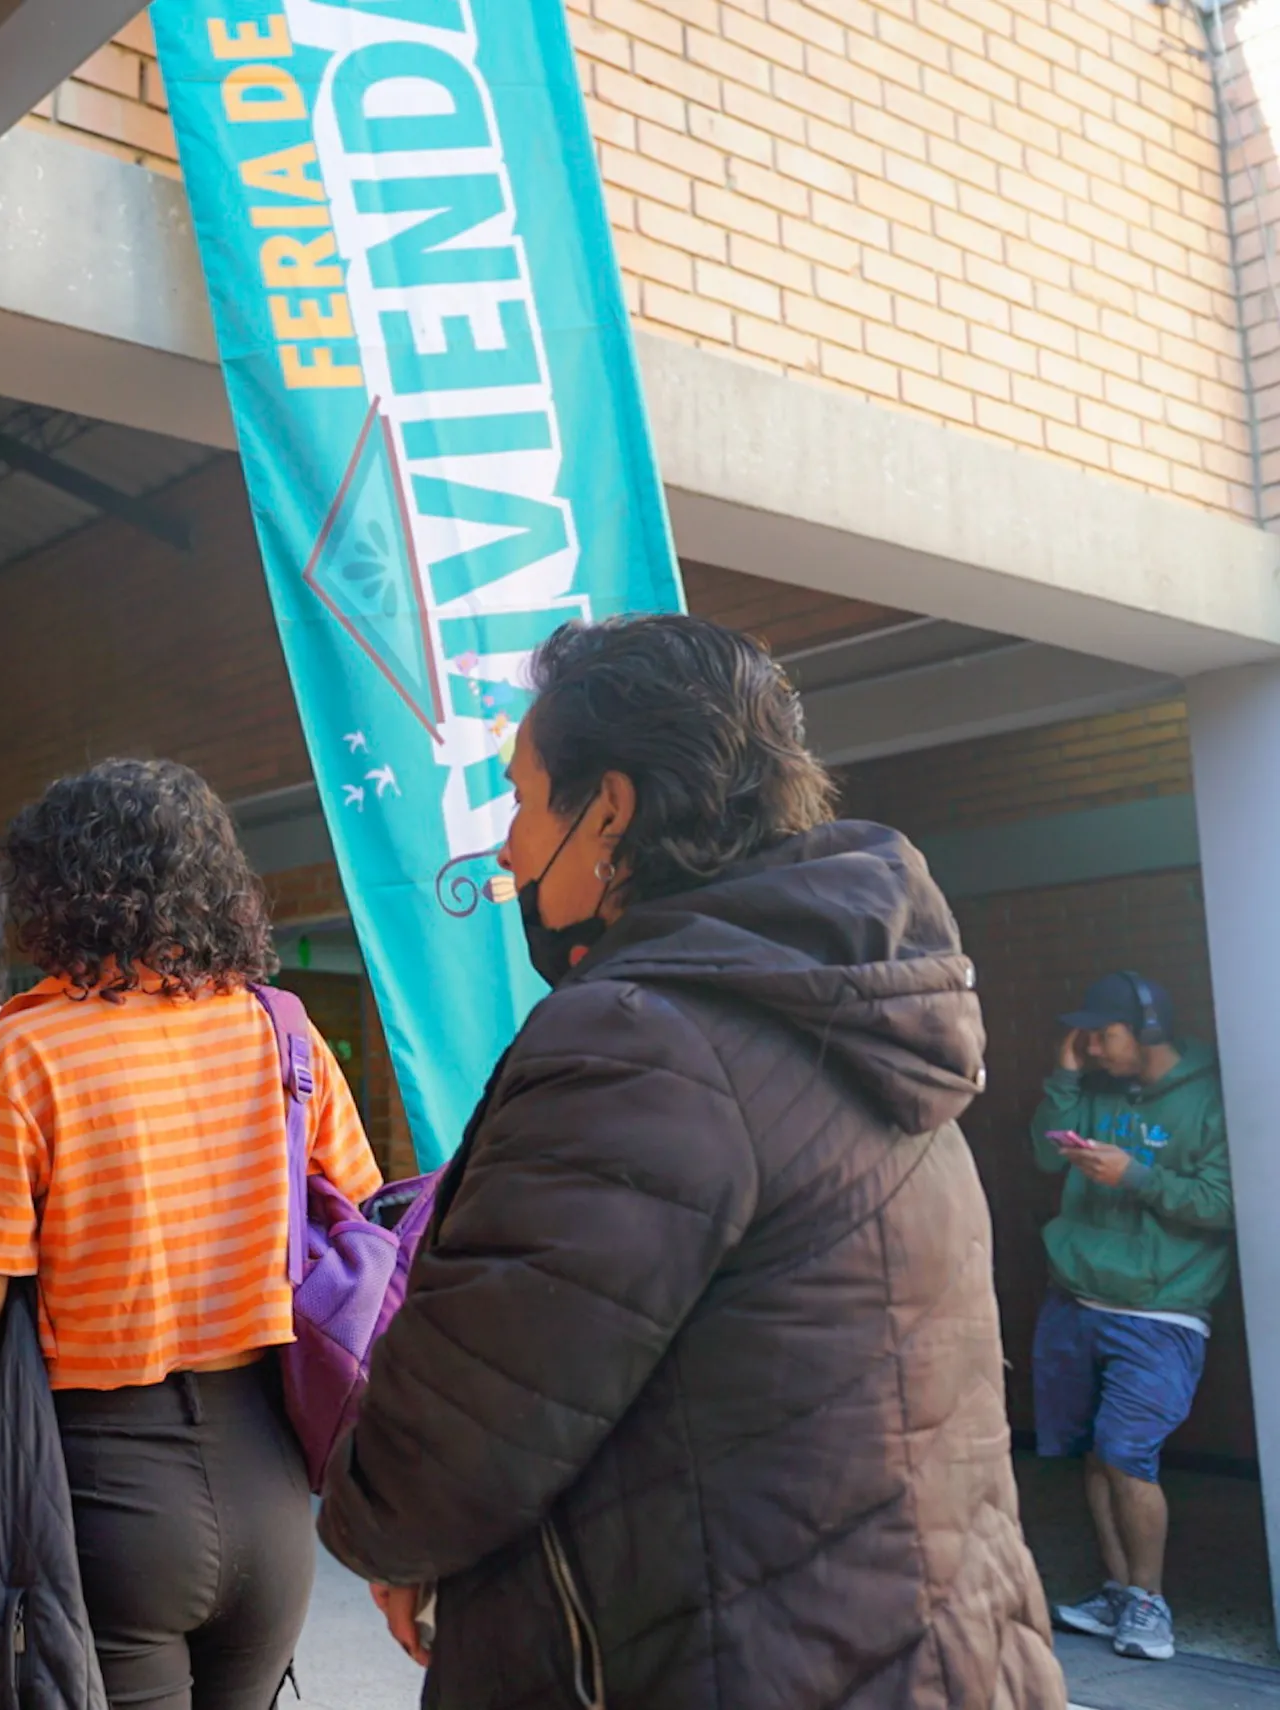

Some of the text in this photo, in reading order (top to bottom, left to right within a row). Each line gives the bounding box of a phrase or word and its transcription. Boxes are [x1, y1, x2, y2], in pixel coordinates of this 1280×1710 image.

[206, 13, 363, 390] FERIA DE
[308, 0, 584, 812] IVIEND
